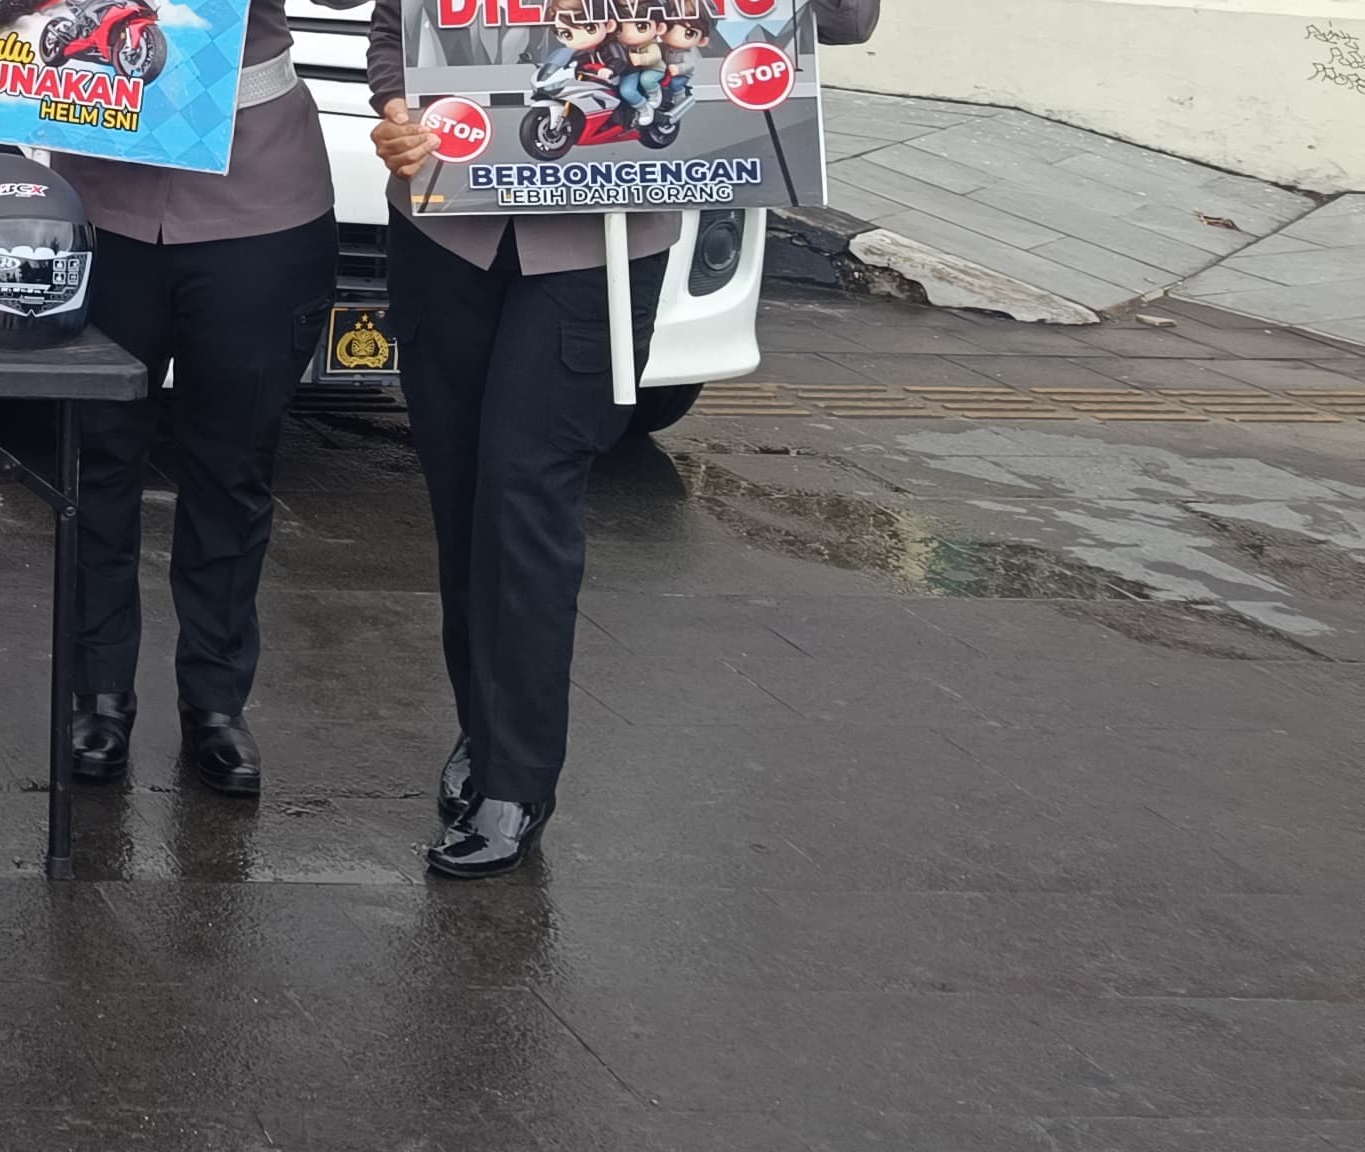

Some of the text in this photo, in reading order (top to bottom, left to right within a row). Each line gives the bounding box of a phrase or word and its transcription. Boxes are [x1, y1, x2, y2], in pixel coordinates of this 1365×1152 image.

[727, 61, 786, 89] STOP
[40, 100, 138, 132] HELM SNI
[427, 113, 485, 143] STOP
[470, 159, 760, 188] BERBONCENGAN
[498, 187, 566, 206] LEBIH
[572, 186, 627, 205] DARI
[648, 182, 733, 203] ORANG
